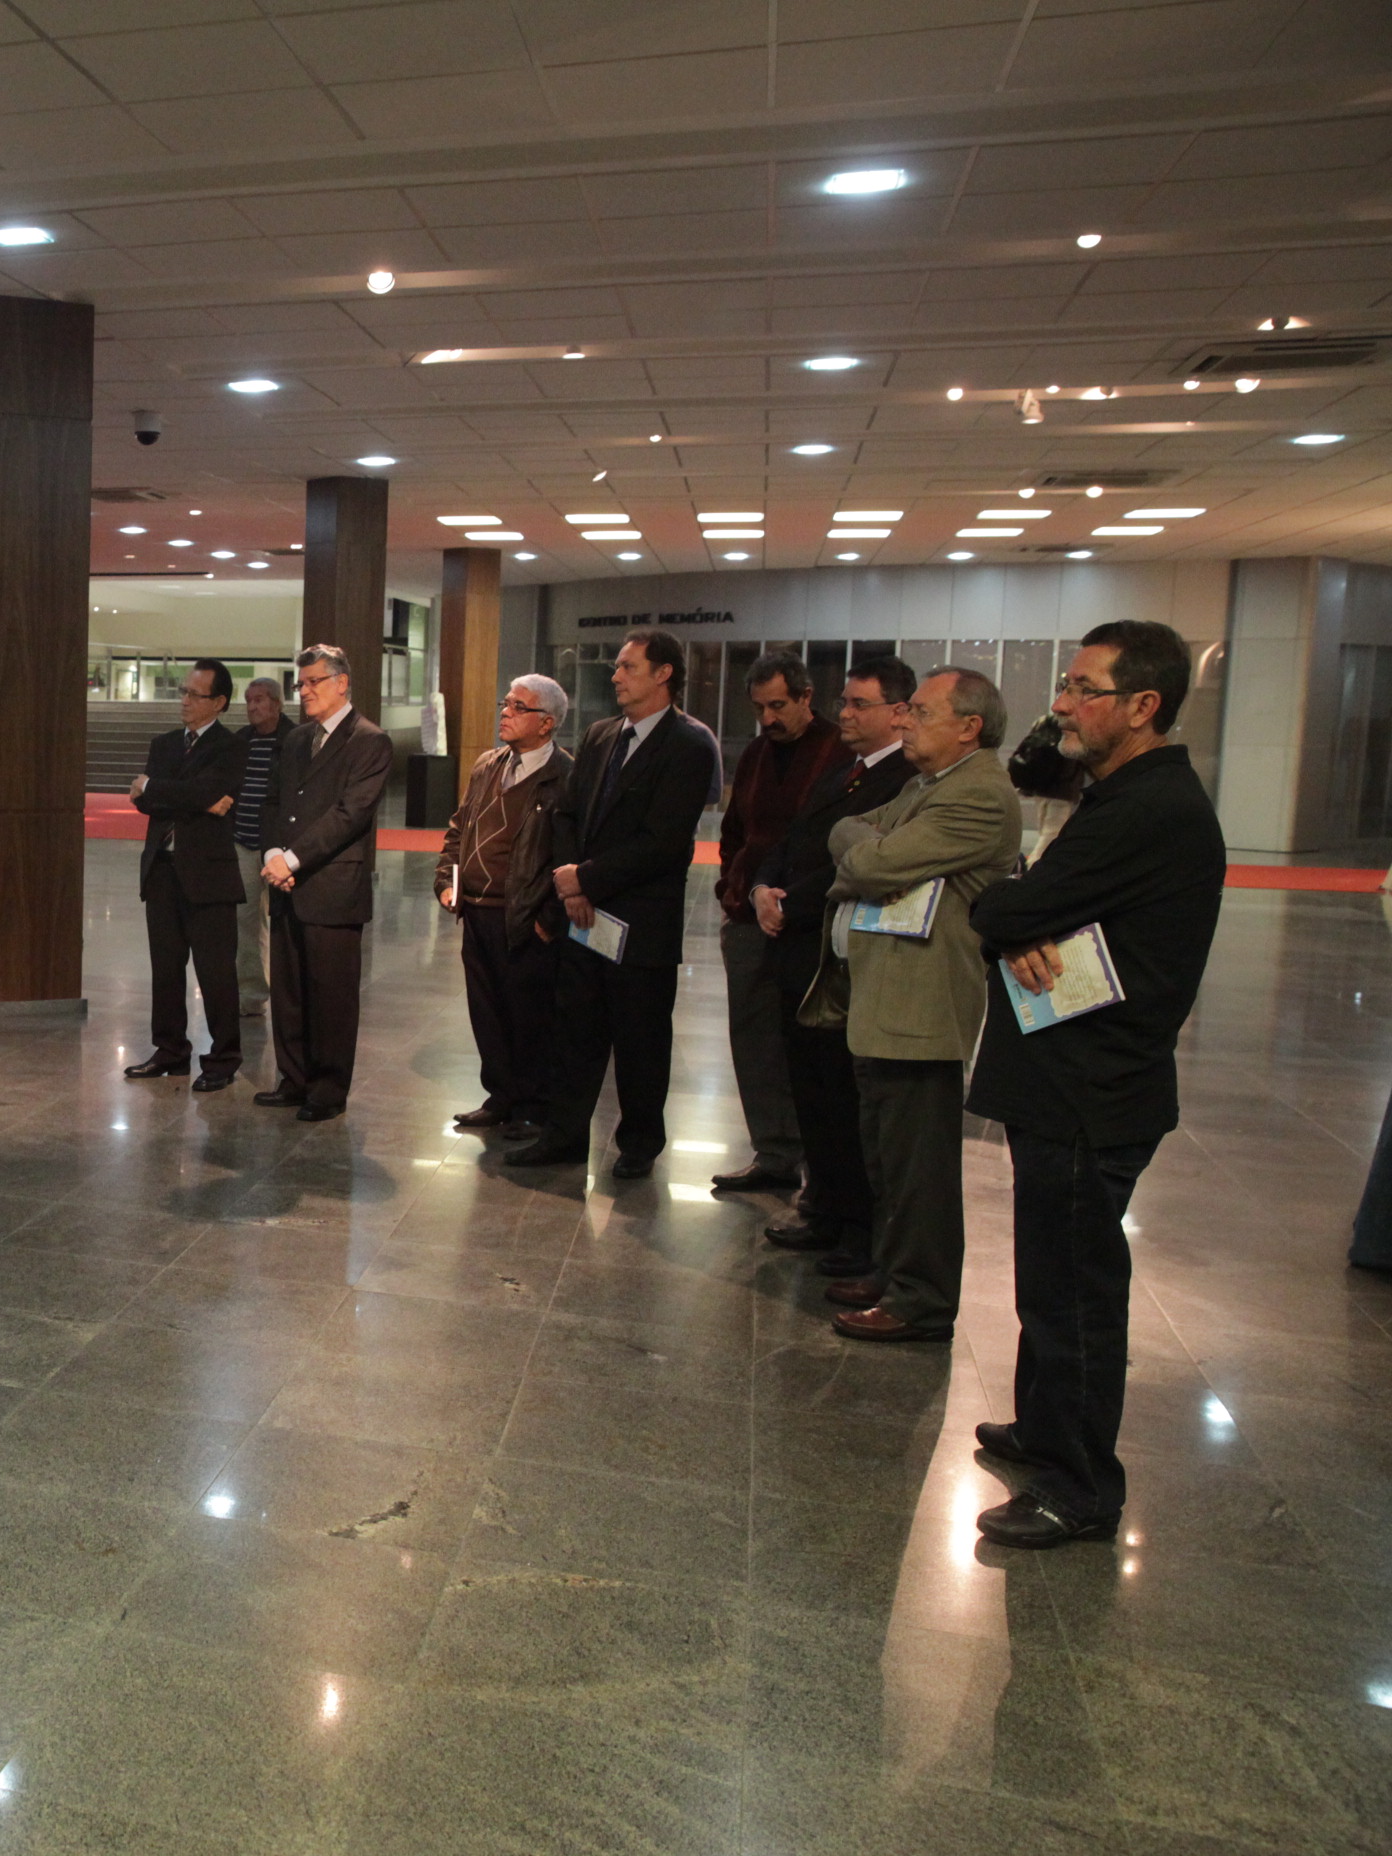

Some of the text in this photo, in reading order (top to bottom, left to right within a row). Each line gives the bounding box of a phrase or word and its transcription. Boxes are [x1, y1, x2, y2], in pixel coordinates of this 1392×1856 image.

[578, 607, 735, 628] CENTRO DE MEMÓRIA
